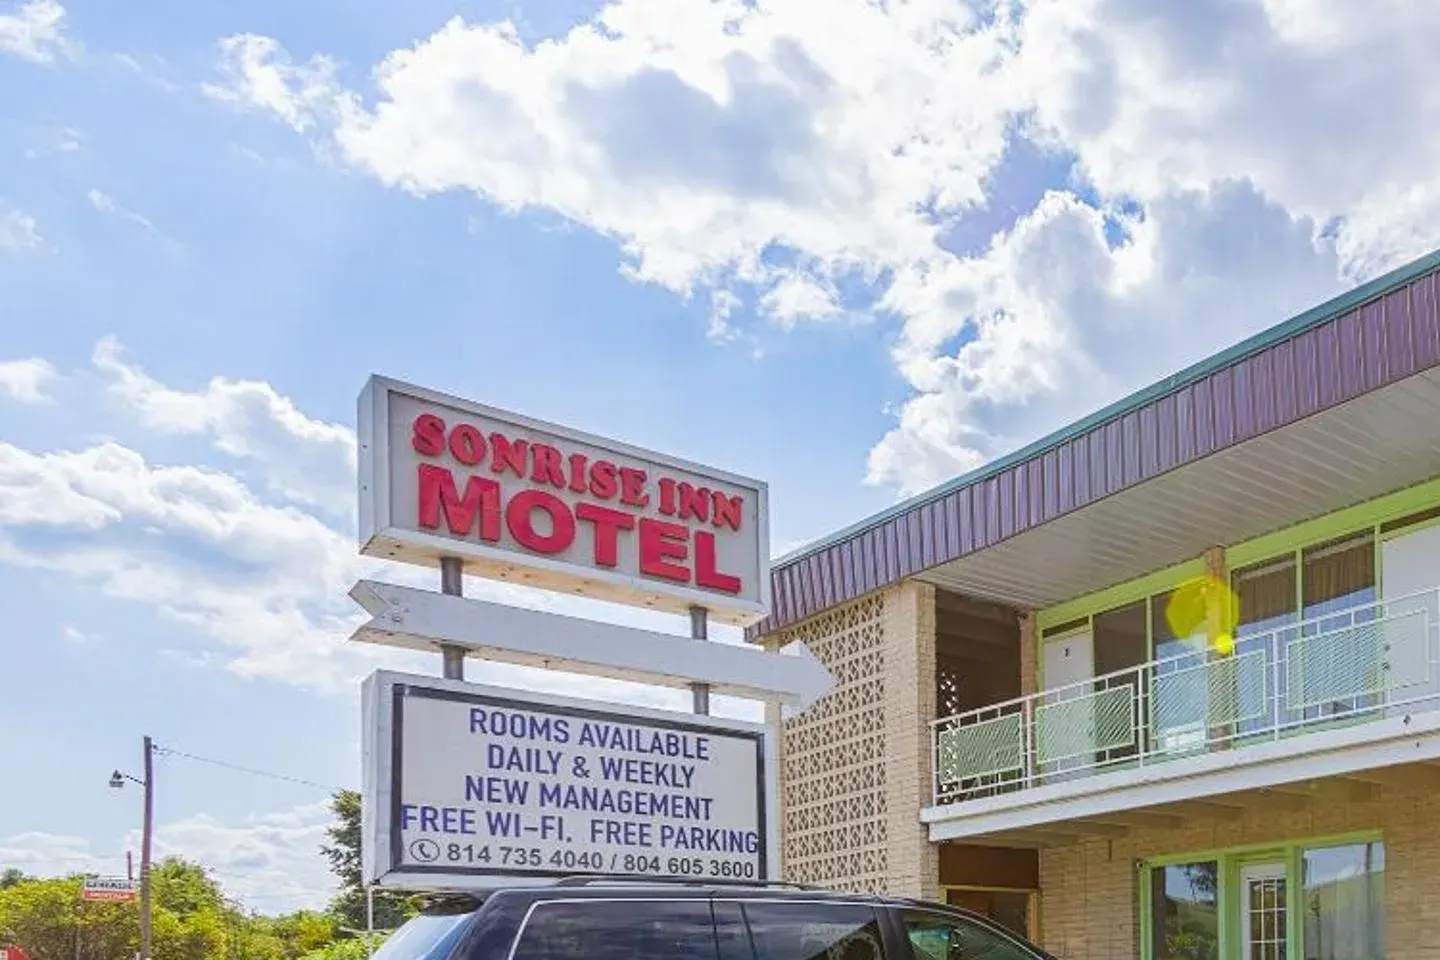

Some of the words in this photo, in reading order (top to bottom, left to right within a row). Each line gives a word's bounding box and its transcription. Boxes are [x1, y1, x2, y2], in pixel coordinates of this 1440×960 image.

[412, 412, 650, 507] SONRISE
[658, 476, 744, 531] INN
[417, 462, 742, 594] MOTEL
[469, 707, 570, 744] ROOMS
[578, 724, 710, 761] AVAILABLE
[487, 744, 562, 777] DAILY
[572, 755, 590, 778] &
[599, 755, 696, 788] WEEKLY
[465, 775, 529, 806] NEW
[539, 782, 713, 821] MANAGEMENT
[402, 804, 476, 835] FREE
[590, 819, 652, 848] FREE
[660, 824, 759, 854] PARKING
[447, 843, 492, 864] 814
[500, 846, 541, 866] 735
[550, 849, 604, 870] 4040
[623, 853, 661, 873] 804
[668, 856, 704, 875] 605
[709, 859, 754, 879] 3600
